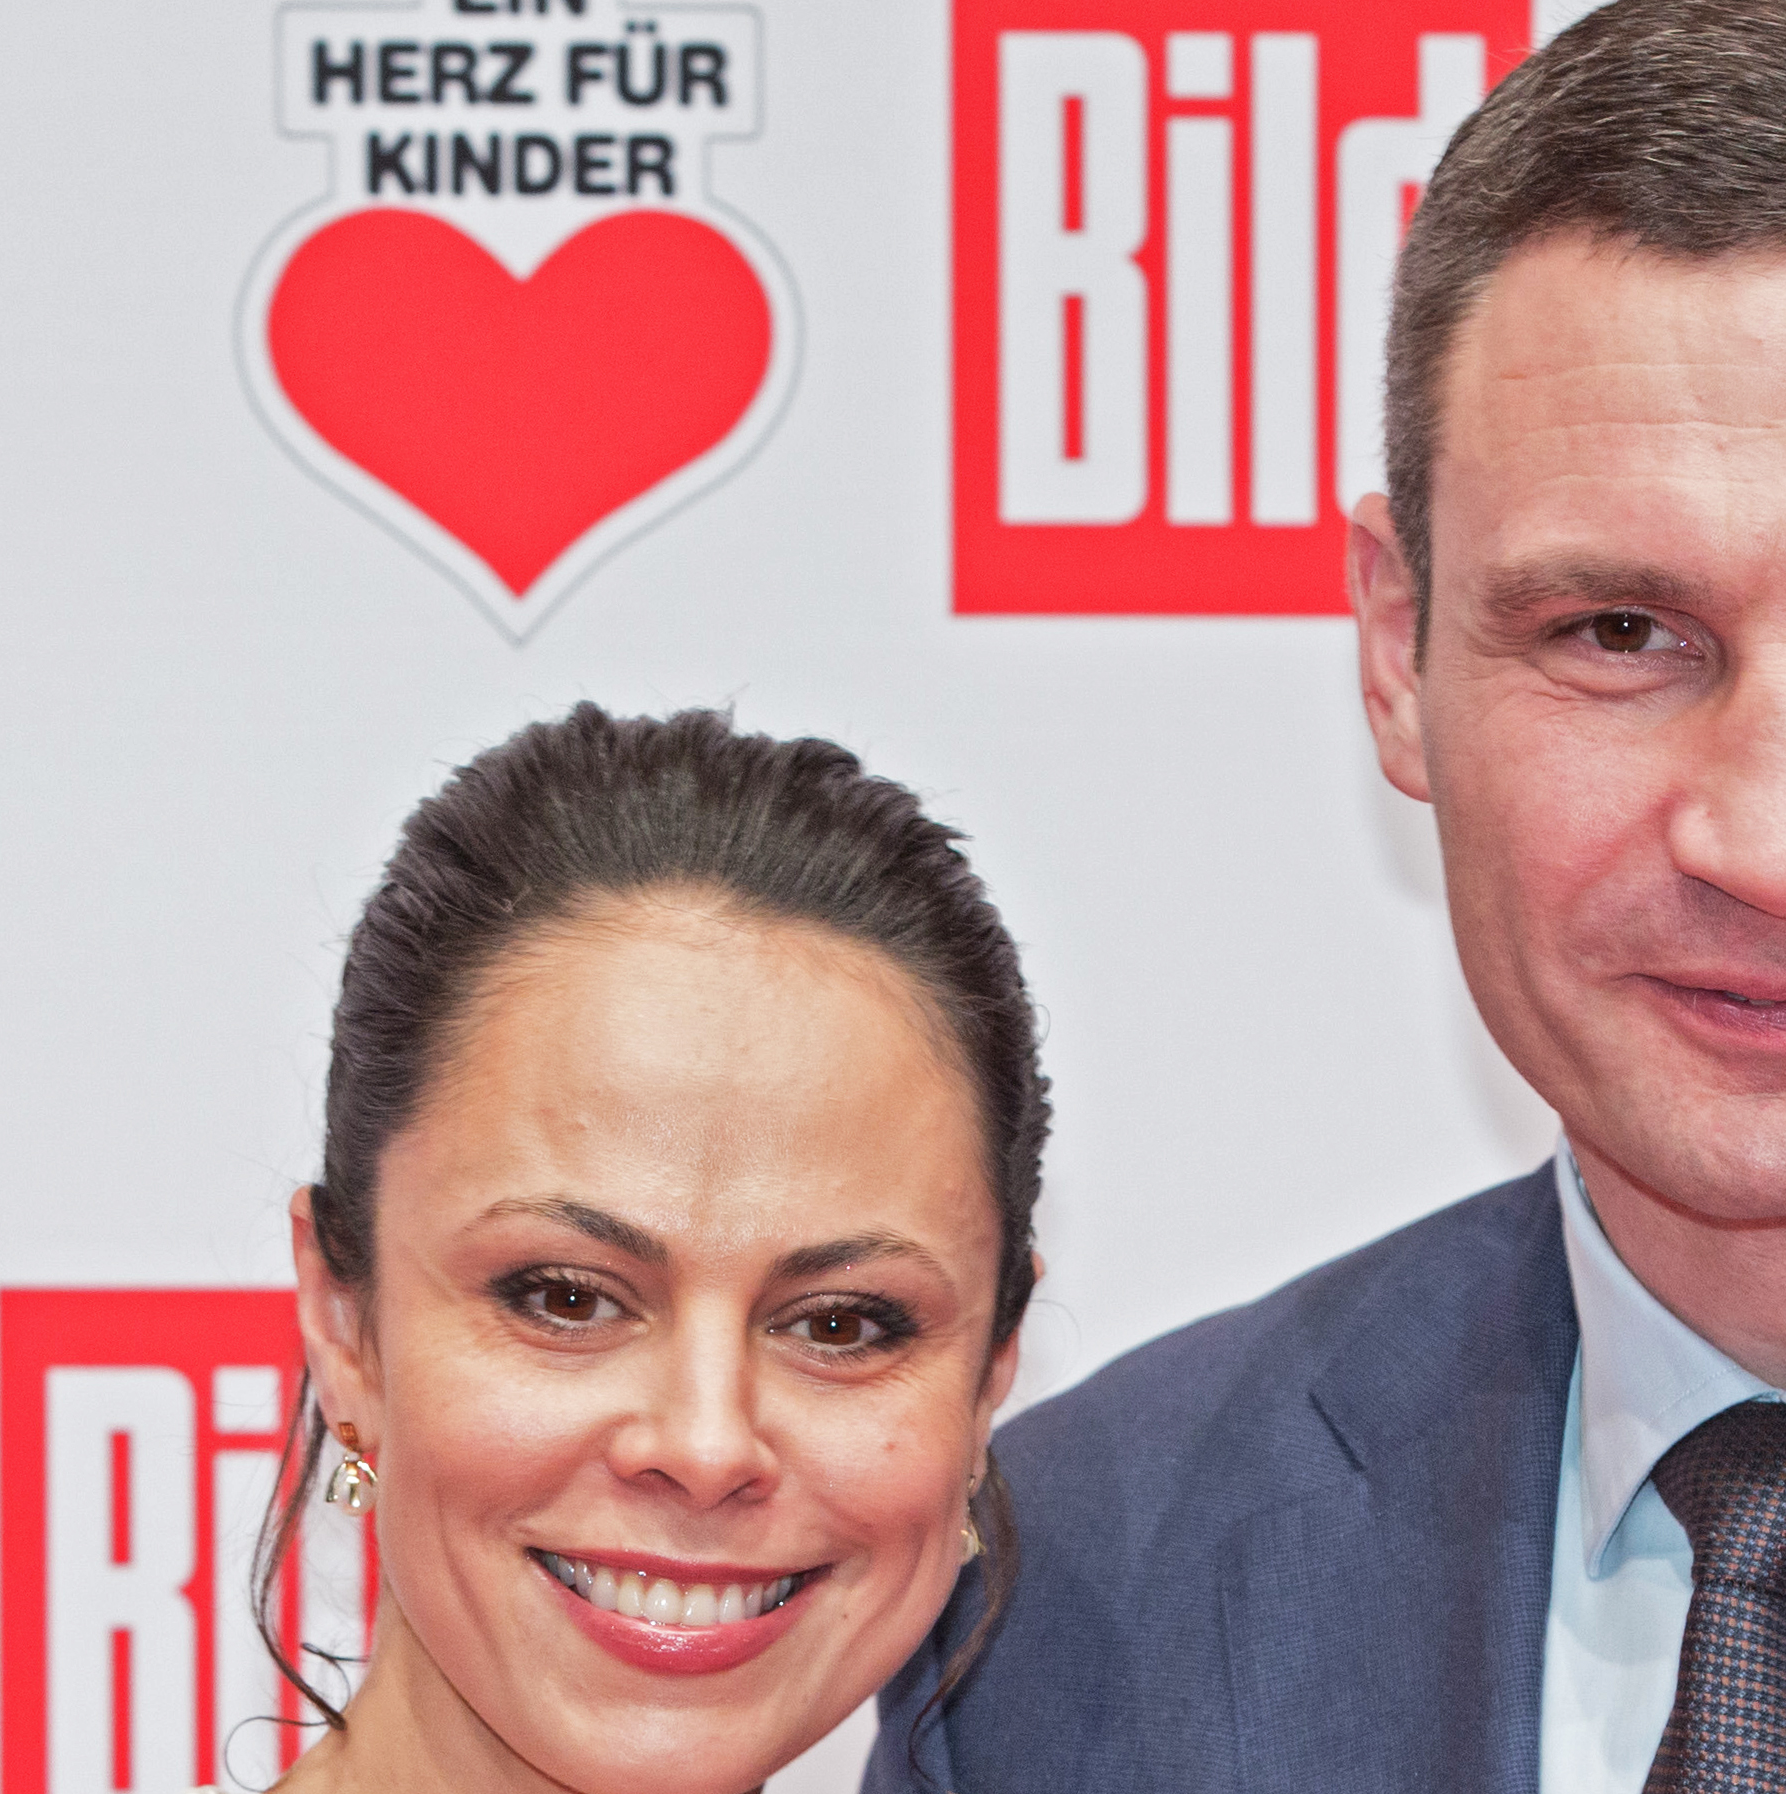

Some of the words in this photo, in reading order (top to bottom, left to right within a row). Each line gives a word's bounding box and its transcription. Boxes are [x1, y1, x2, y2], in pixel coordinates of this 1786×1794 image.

[312, 40, 536, 106] HERZ
[566, 21, 728, 108] FÜR
[366, 132, 676, 197] KINDER
